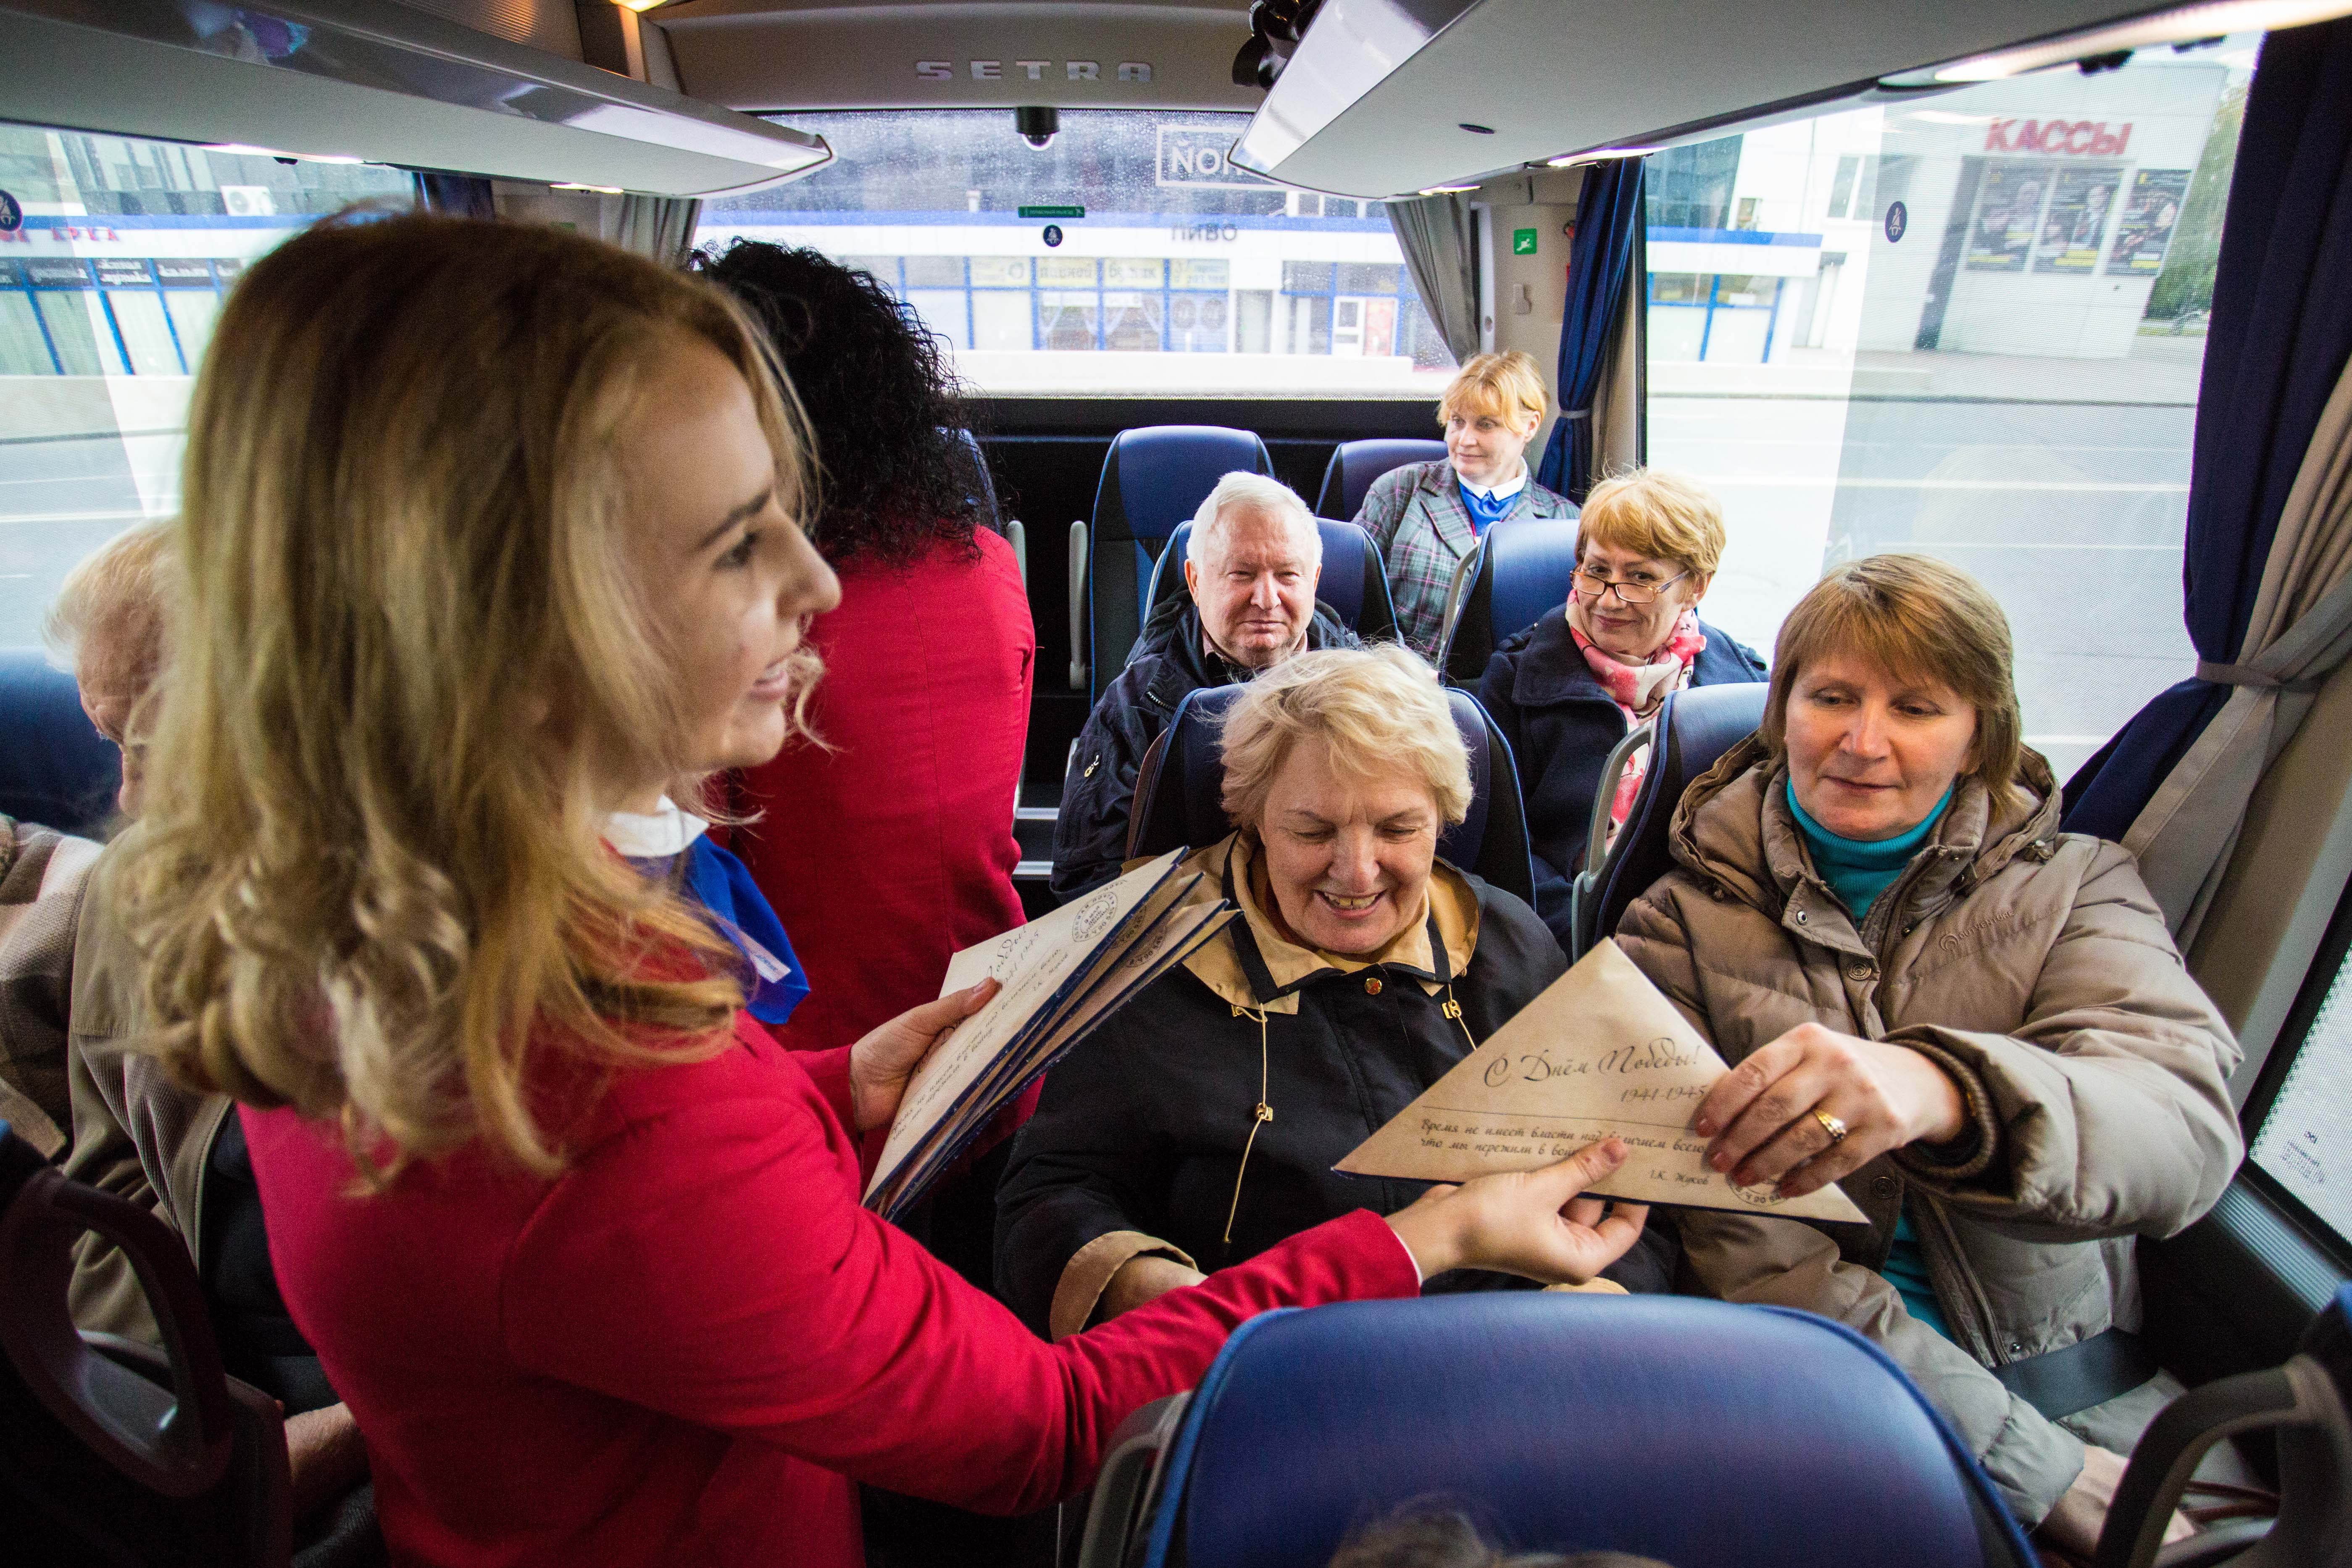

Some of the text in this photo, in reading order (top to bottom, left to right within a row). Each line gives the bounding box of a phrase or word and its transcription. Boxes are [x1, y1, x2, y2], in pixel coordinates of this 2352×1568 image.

[916, 60, 1154, 83] SETRA
[1984, 116, 2133, 155] КАССЫ
[1171, 223, 1238, 242] ПИВО
[1957, 911, 2015, 940] OUTVENTURE
[1484, 1037, 1700, 1088] С Днём Победы!
[1421, 1118, 1459, 1136] Время
[1465, 1126, 1479, 1135] не
[1485, 1127, 1524, 1137] имеет
[1531, 1126, 1574, 1140] власти
[1421, 1138, 1443, 1148] что
[1475, 1144, 1532, 1157] пережили
[1538, 1143, 1546, 1155] в
[1676, 1173, 1710, 1186] Жуков
